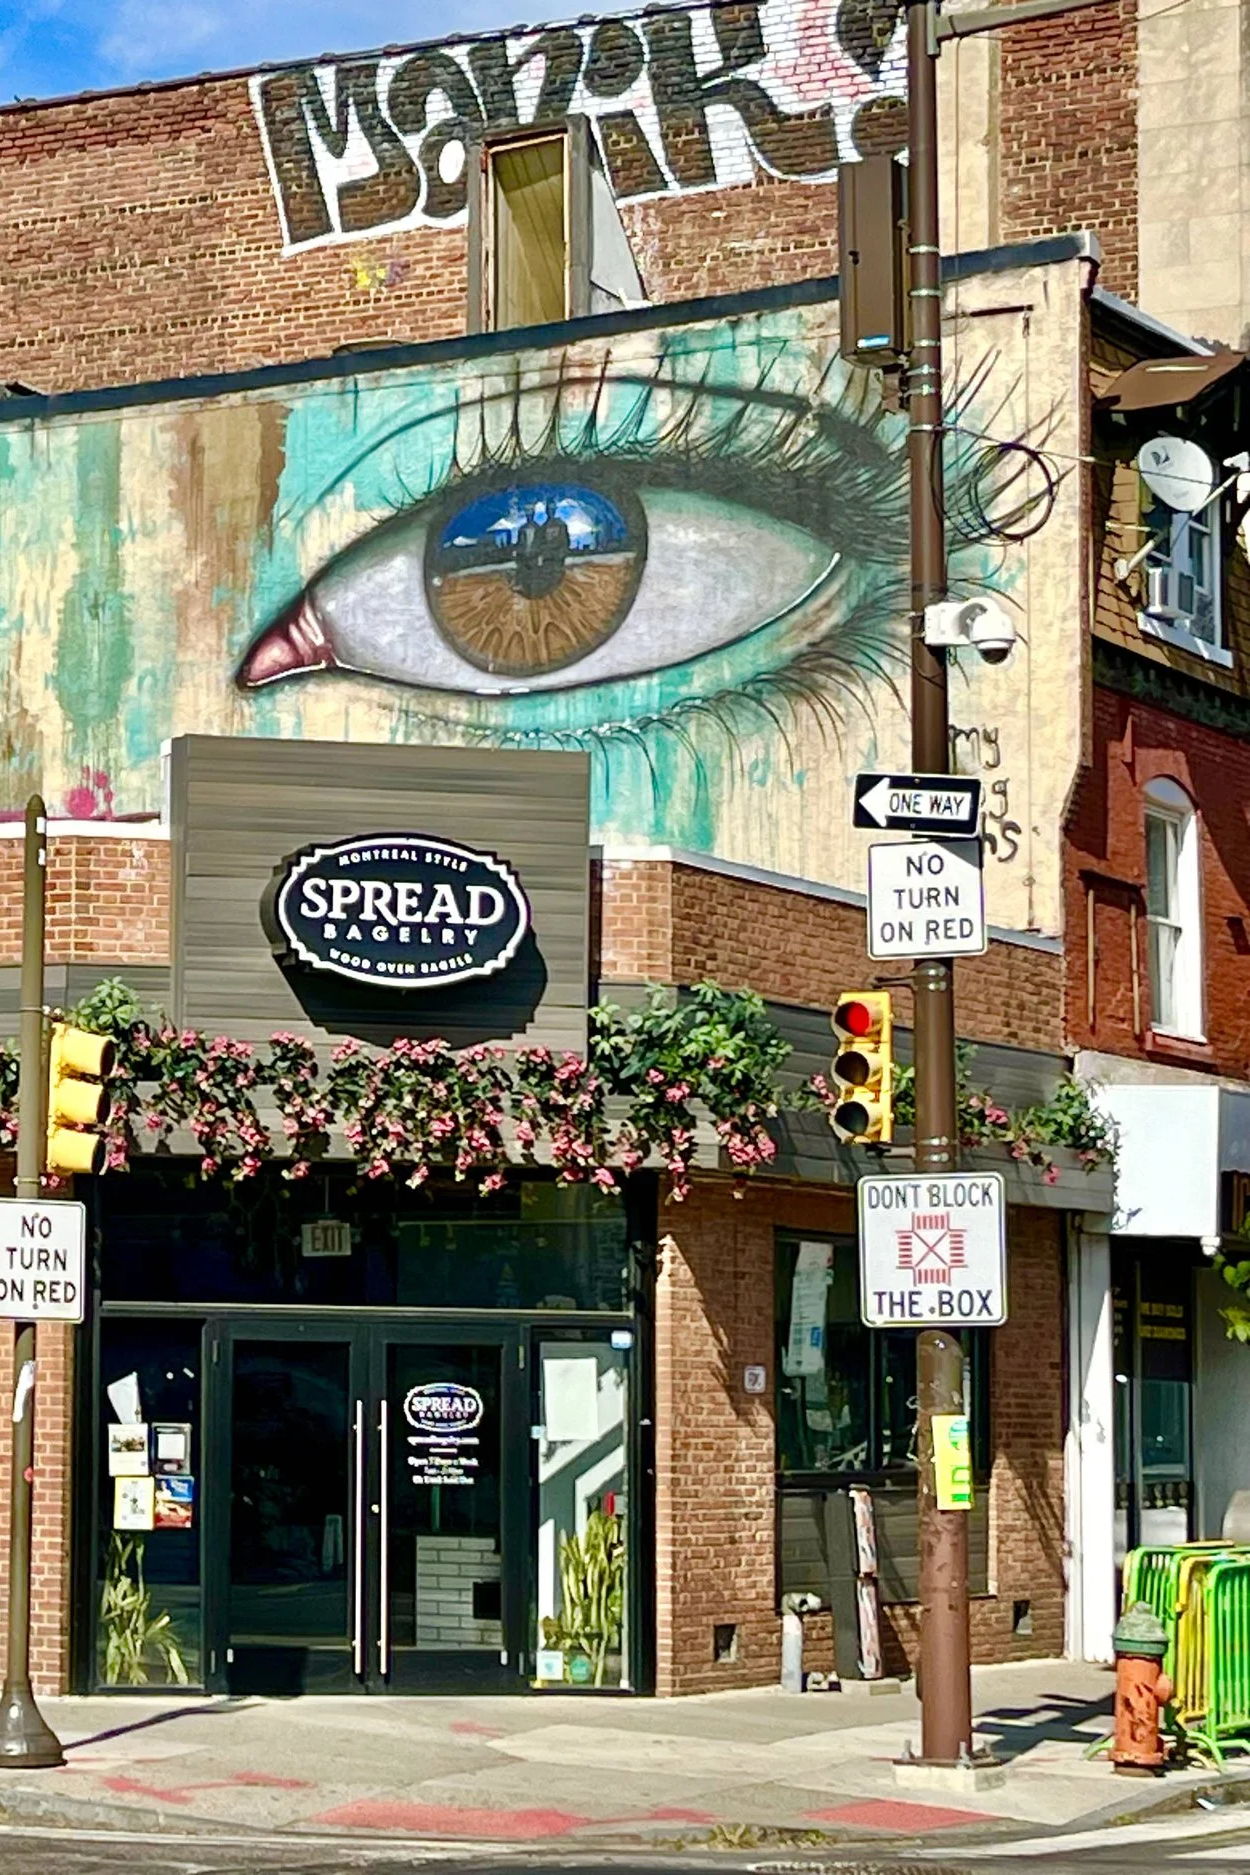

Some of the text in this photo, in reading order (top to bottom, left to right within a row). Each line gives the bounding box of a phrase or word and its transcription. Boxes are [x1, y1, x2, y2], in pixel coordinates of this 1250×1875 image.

[889, 793, 964, 816] ONE WAY
[339, 848, 467, 872] MONTREAL STYLE
[906, 854, 945, 876] NO
[300, 877, 505, 926] SPREAD
[893, 886, 960, 910] TURN
[323, 923, 478, 946] BAGELRY
[881, 918, 974, 943] ON RED
[330, 948, 472, 974] WOOD OVEN BAGELS
[929, 1182, 993, 1207] BLOCK
[21, 1215, 52, 1238] NO
[6, 1247, 67, 1271] TURN
[33, 1280, 76, 1303] RED
[873, 1290, 993, 1317] THE BOX
[411, 1397, 477, 1413] SPREAD
